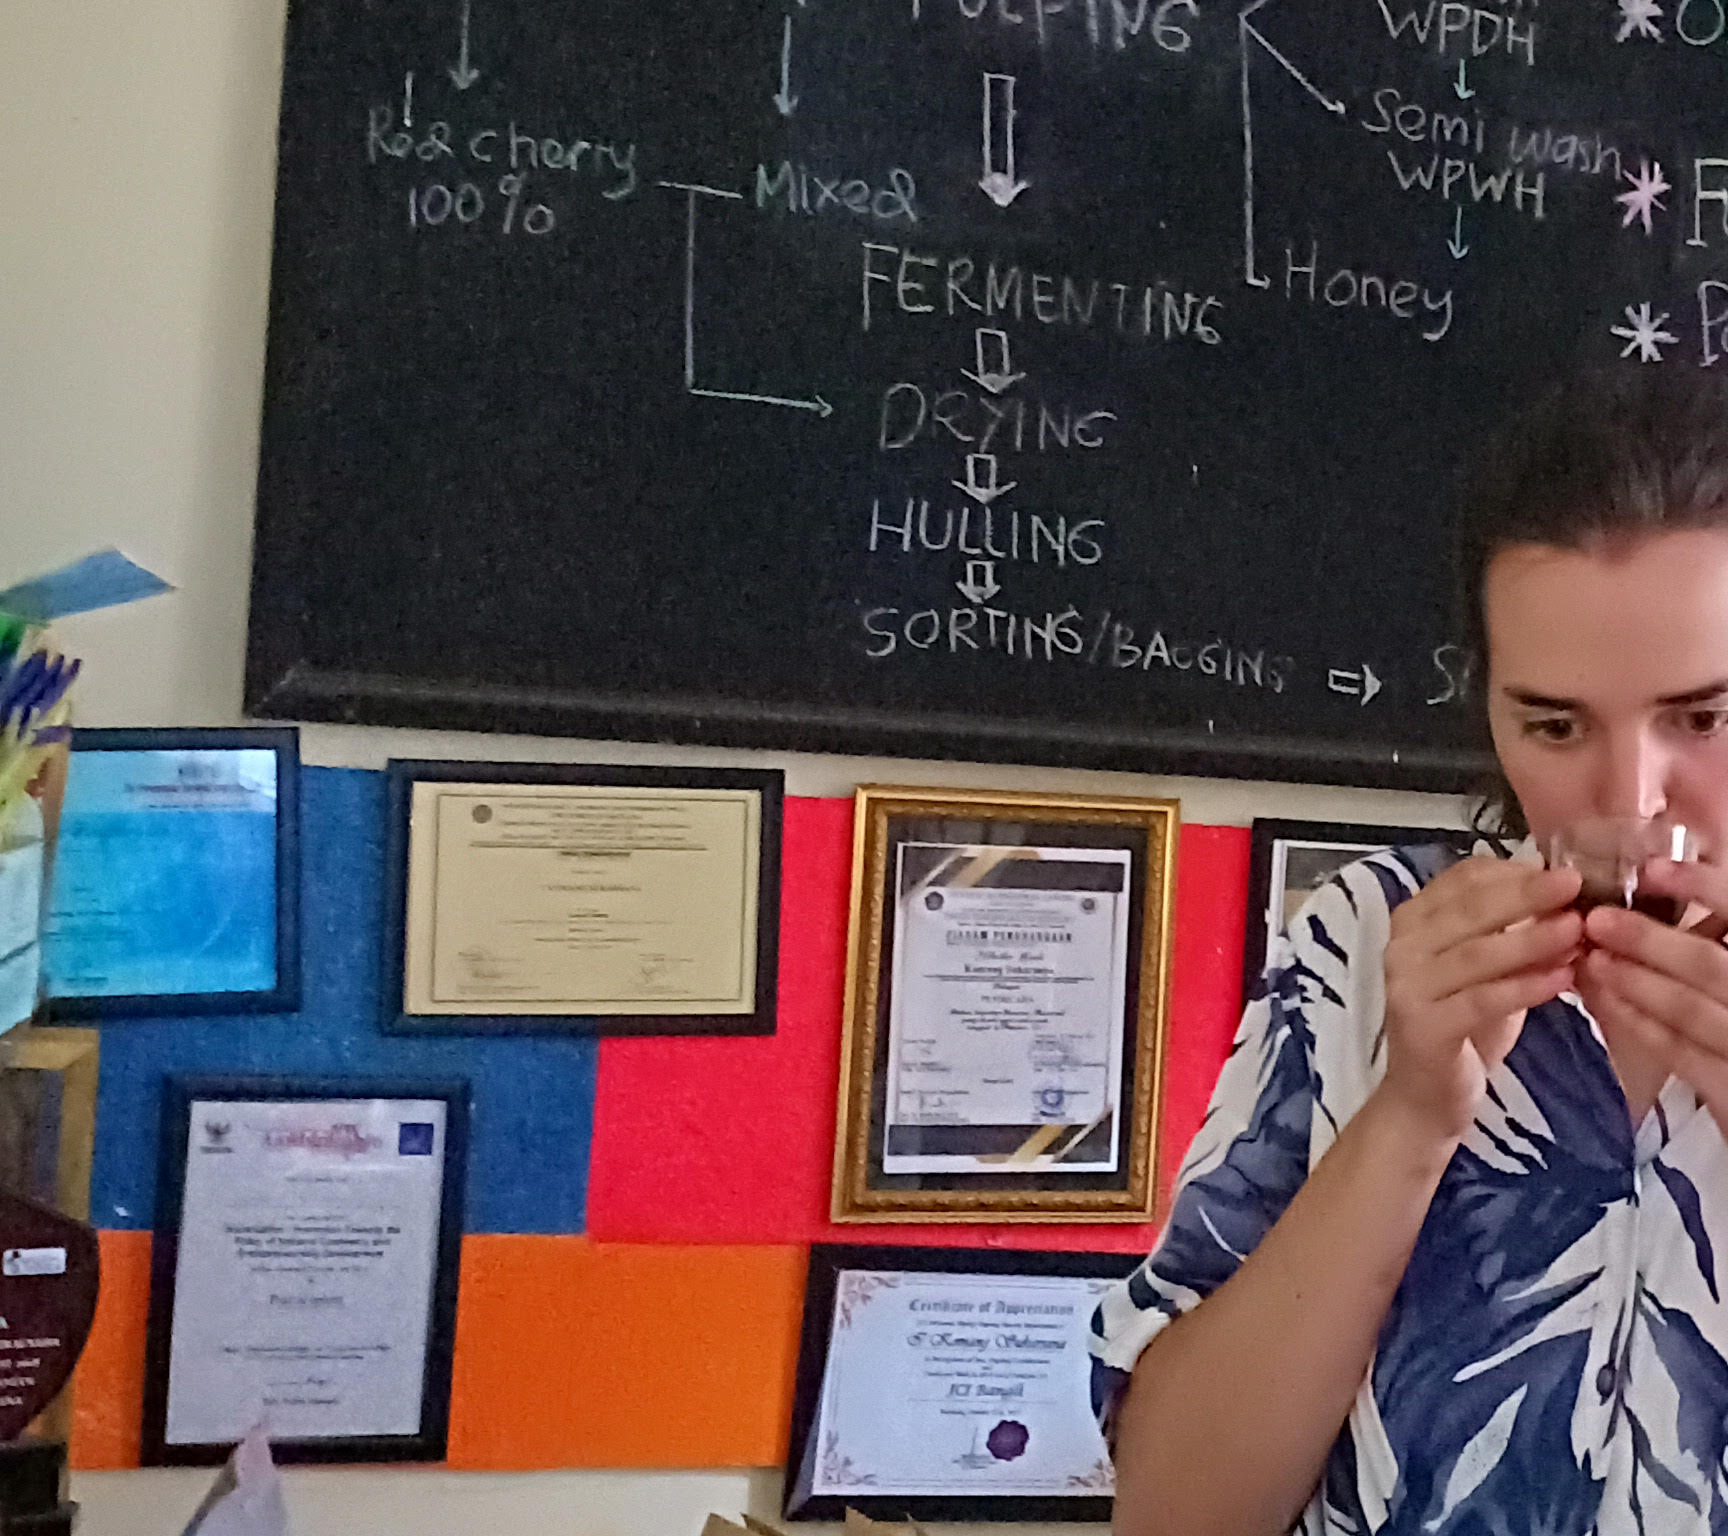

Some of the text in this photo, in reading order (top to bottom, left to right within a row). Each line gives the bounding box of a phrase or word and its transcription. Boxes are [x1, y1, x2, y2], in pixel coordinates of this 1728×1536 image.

[1361, 88, 1486, 156] Semi
[408, 168, 555, 235] 100%
[1386, 149, 1546, 222] WPWH
[860, 240, 1224, 346] FERMENTING
[1284, 238, 1454, 343] Honey
[868, 495, 1107, 569] HULLING
